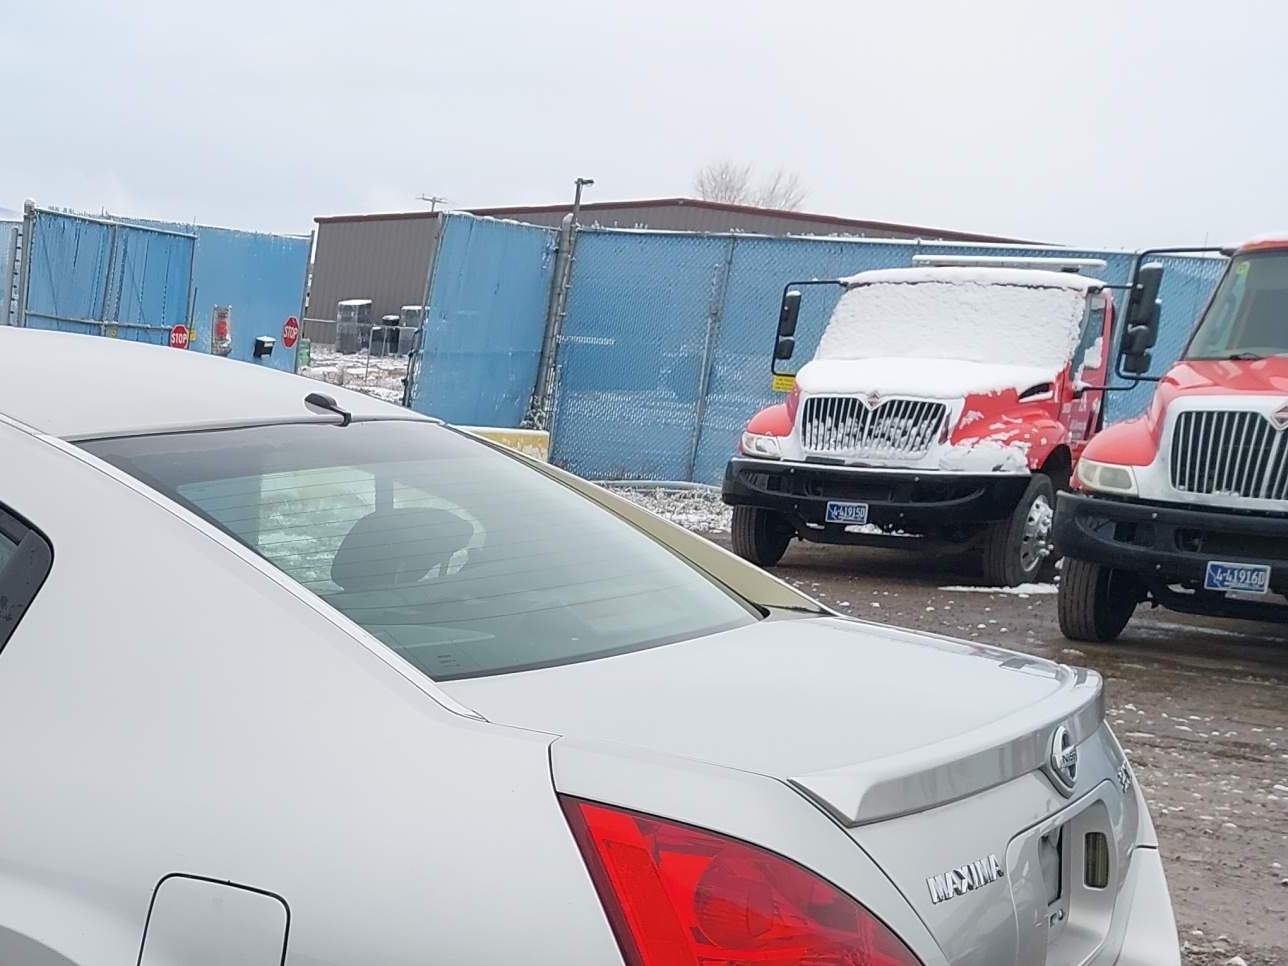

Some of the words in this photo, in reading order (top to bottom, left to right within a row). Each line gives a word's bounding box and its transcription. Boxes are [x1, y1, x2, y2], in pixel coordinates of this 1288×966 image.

[171, 332, 188, 344] STOP
[283, 326, 298, 338] STOP
[926, 854, 1004, 904] MAXIMA
